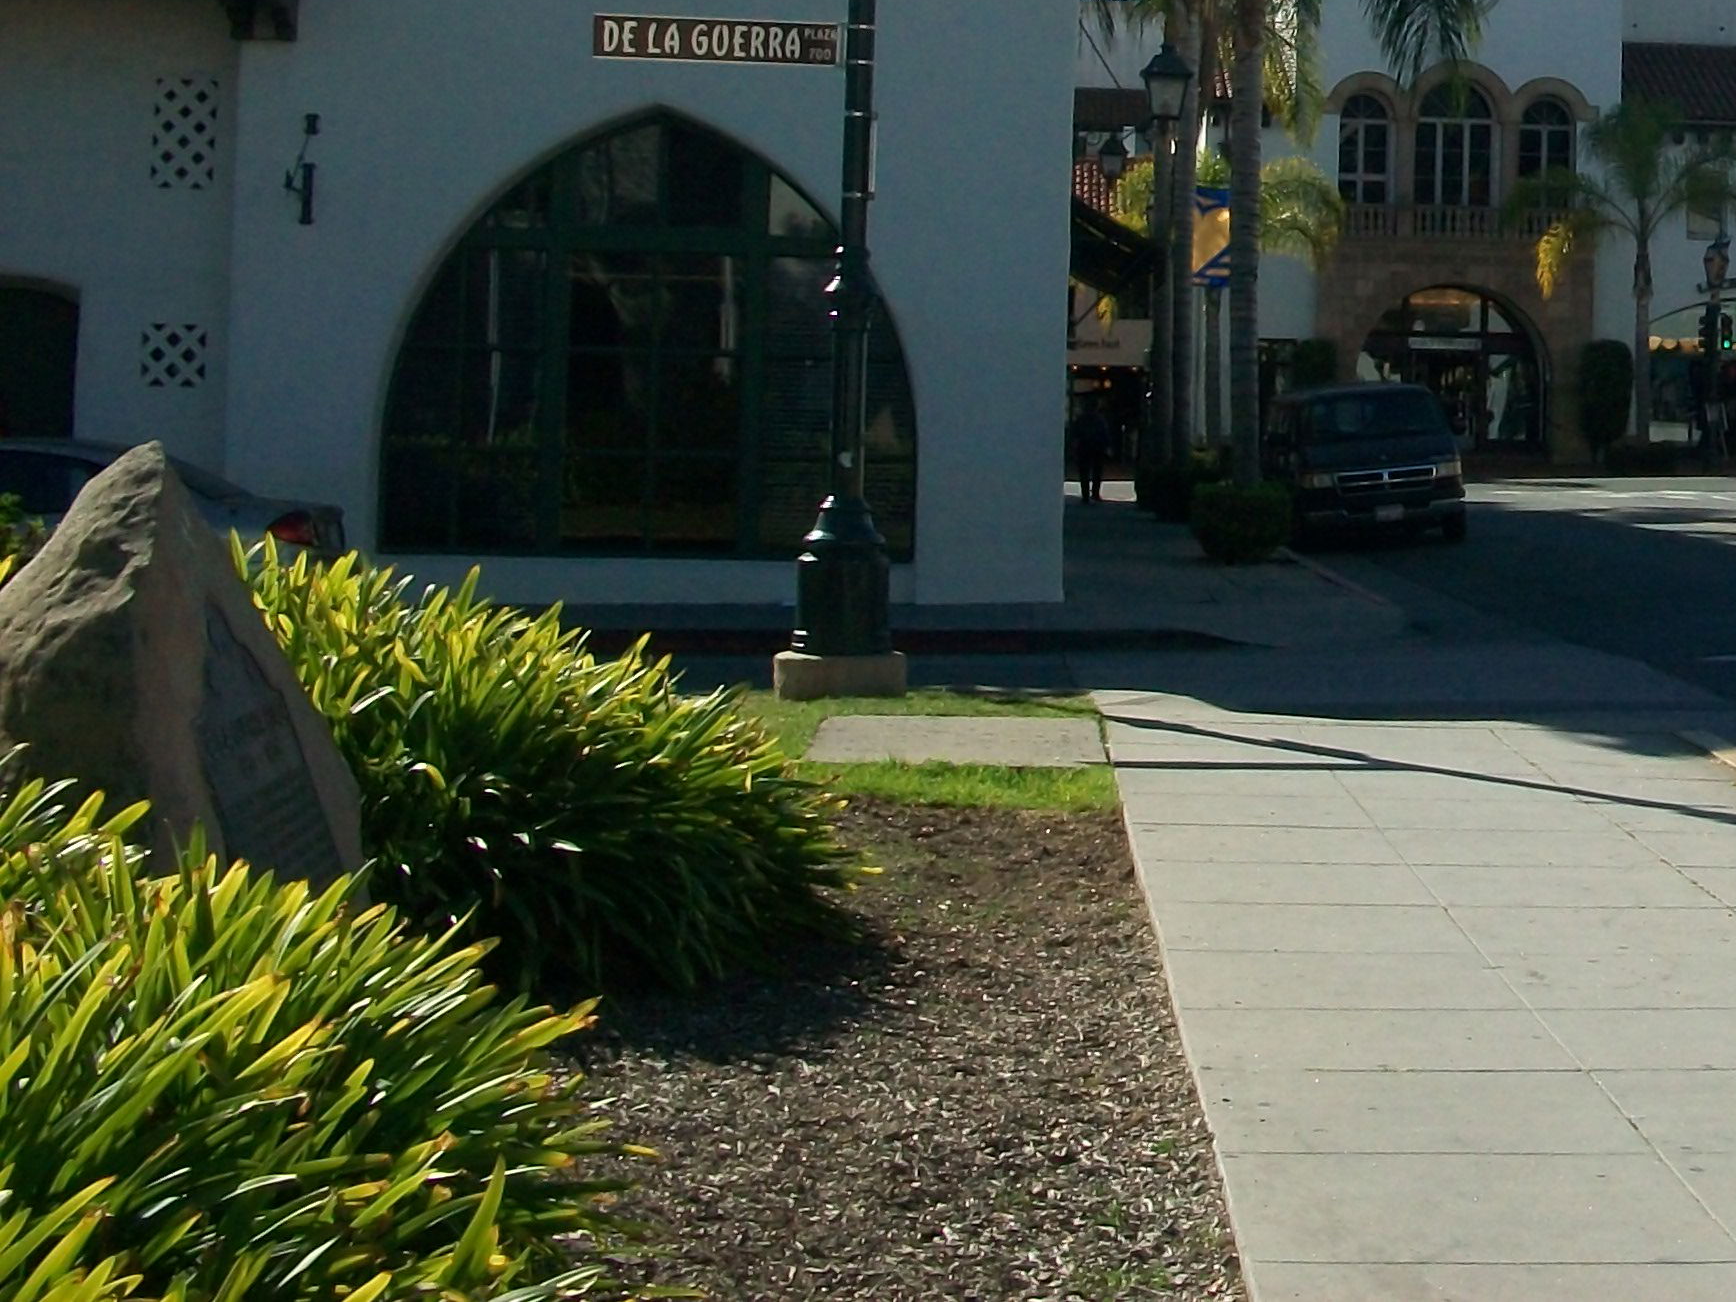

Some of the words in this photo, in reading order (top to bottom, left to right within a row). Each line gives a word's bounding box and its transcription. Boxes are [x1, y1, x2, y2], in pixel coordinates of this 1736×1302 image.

[603, 20, 638, 53] DE
[647, 22, 680, 55] LA
[691, 24, 800, 59] GUERRA
[809, 48, 832, 61] 700
